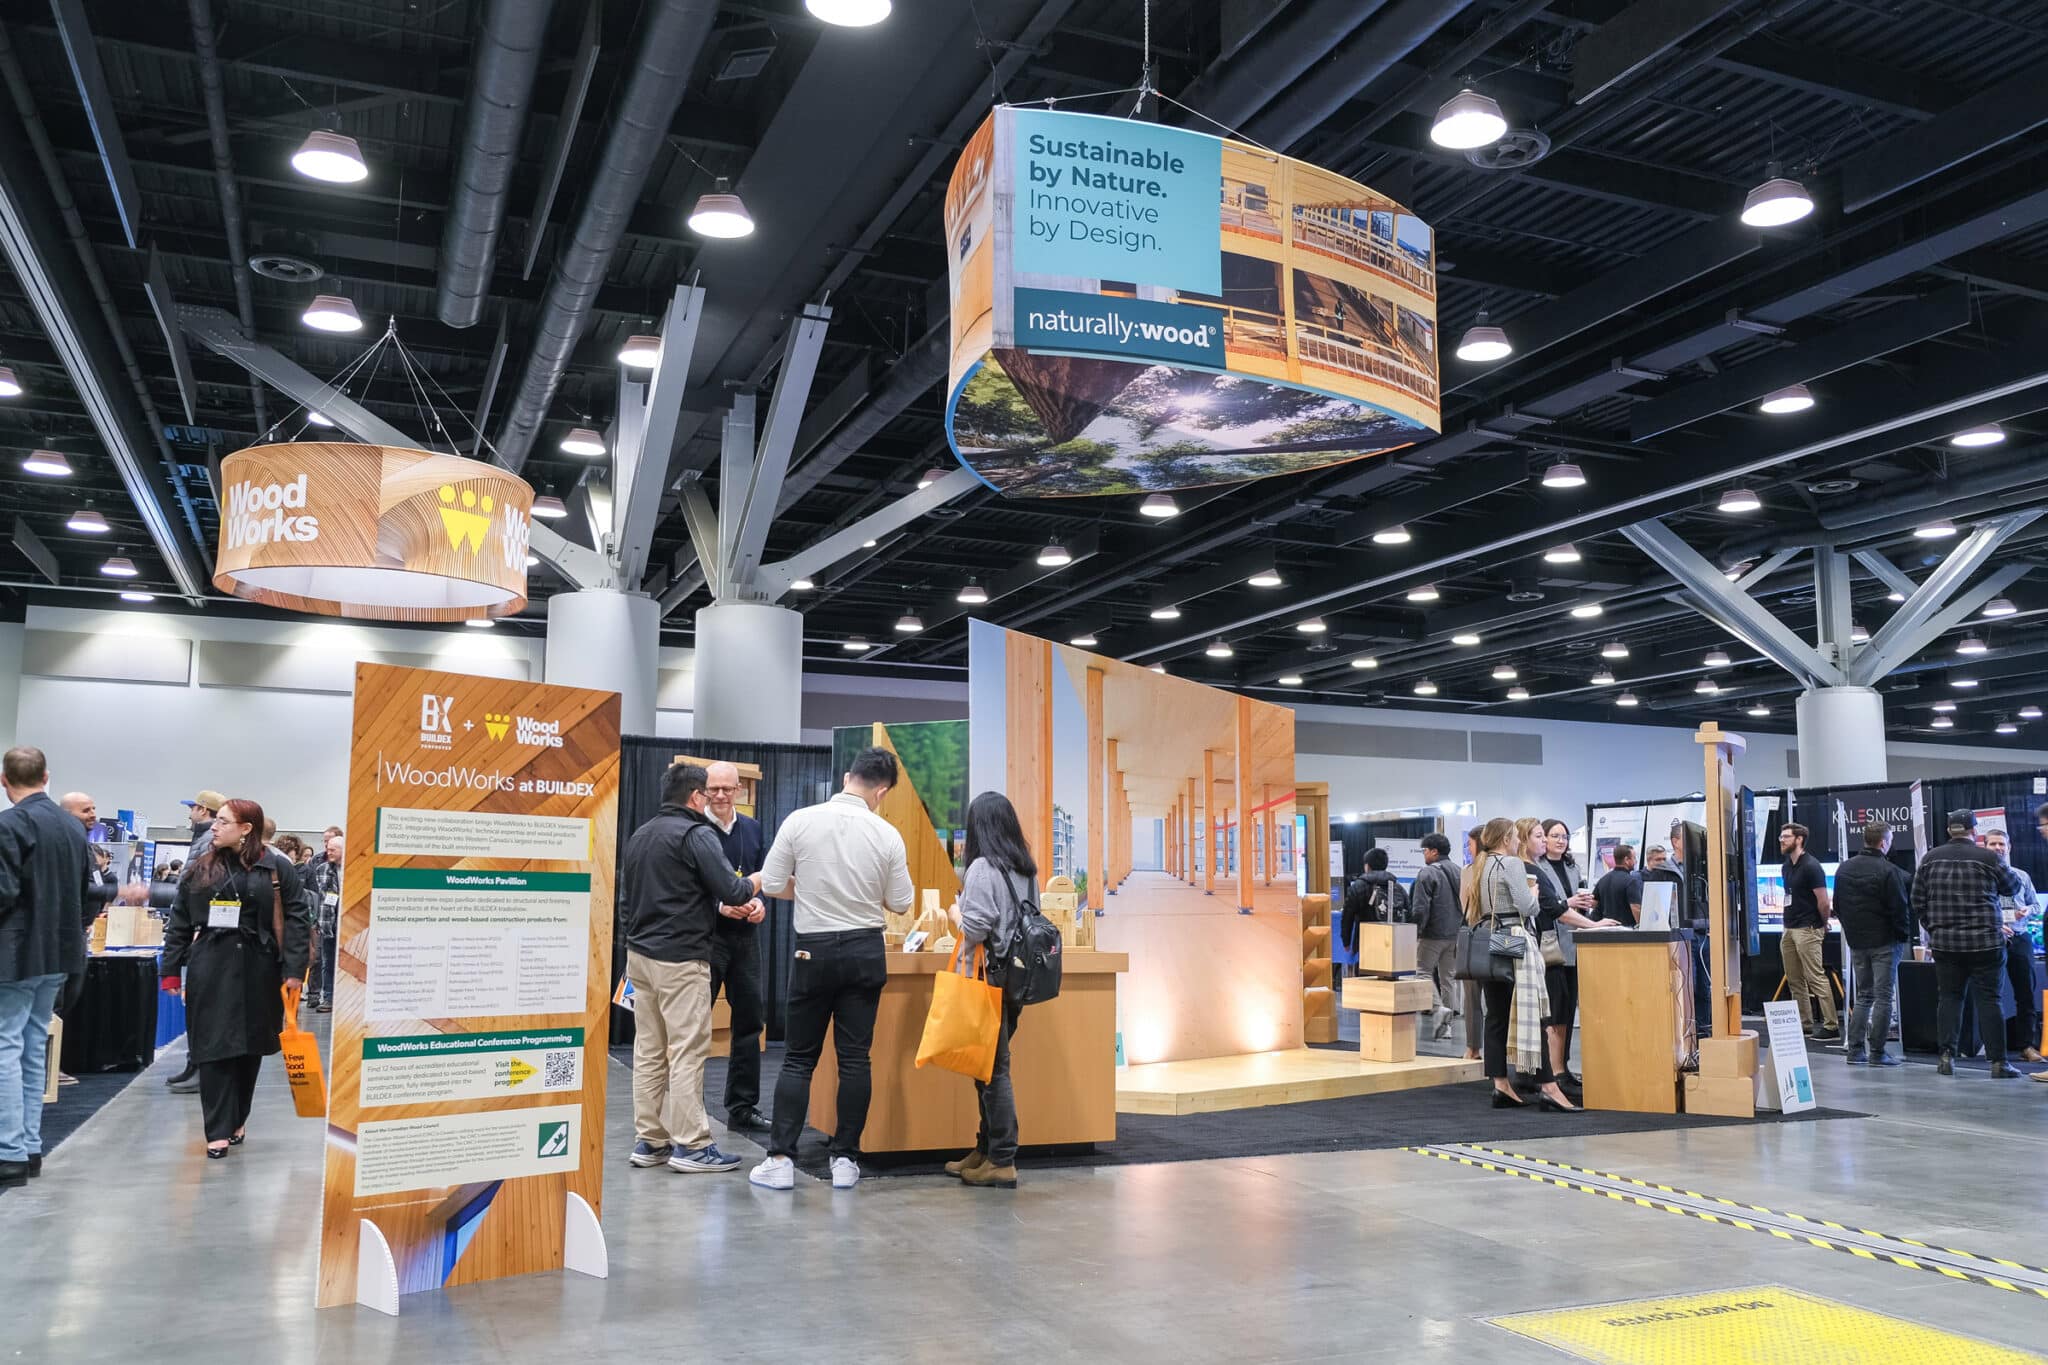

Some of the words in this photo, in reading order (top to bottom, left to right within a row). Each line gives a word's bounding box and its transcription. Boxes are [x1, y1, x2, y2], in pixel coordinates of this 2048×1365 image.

[1029, 134, 1185, 174] Sustainable
[1029, 160, 1062, 188] by
[1072, 165, 1168, 198] Nature.
[1030, 189, 1159, 224] Innovative
[1030, 215, 1060, 243] by
[1070, 220, 1162, 252] Design.
[229, 473, 308, 517] Wood
[228, 508, 319, 550] Works
[516, 716, 560, 735] Wood
[420, 732, 452, 744] BUILDEX
[515, 729, 564, 748] Works
[385, 761, 515, 792] WoodWorks
[519, 779, 534, 792] at
[536, 780, 594, 797] BUILDEX
[401, 814, 423, 824] exciting
[438, 816, 473, 824] collaboration
[405, 824, 436, 833] integrating
[475, 827, 499, 835] technical
[501, 828, 525, 837] expertise
[553, 831, 576, 839] products
[1849, 826, 1866, 834] MAS
[386, 833, 409, 841] industry
[411, 834, 452, 842] representation
[385, 841, 423, 850] professionals
[446, 875, 494, 885] WoodWorks
[495, 877, 527, 885] Pavilion
[378, 896, 400, 904] Explore
[454, 897, 475, 905] pavilion
[408, 915, 436, 924] expertise
[527, 916, 552, 924] products
[377, 1042, 429, 1053] WoodWorks
[430, 1039, 477, 1049] Educational
[477, 1037, 521, 1046] Conference
[522, 1034, 572, 1045] Programming
[415, 1062, 446, 1070] accredited
[447, 1060, 479, 1068] educational
[413, 1071, 442, 1079] dedicated
[494, 1069, 531, 1077] conference
[420, 1080, 449, 1088] integrated
[366, 1093, 392, 1101] BUILDEX
